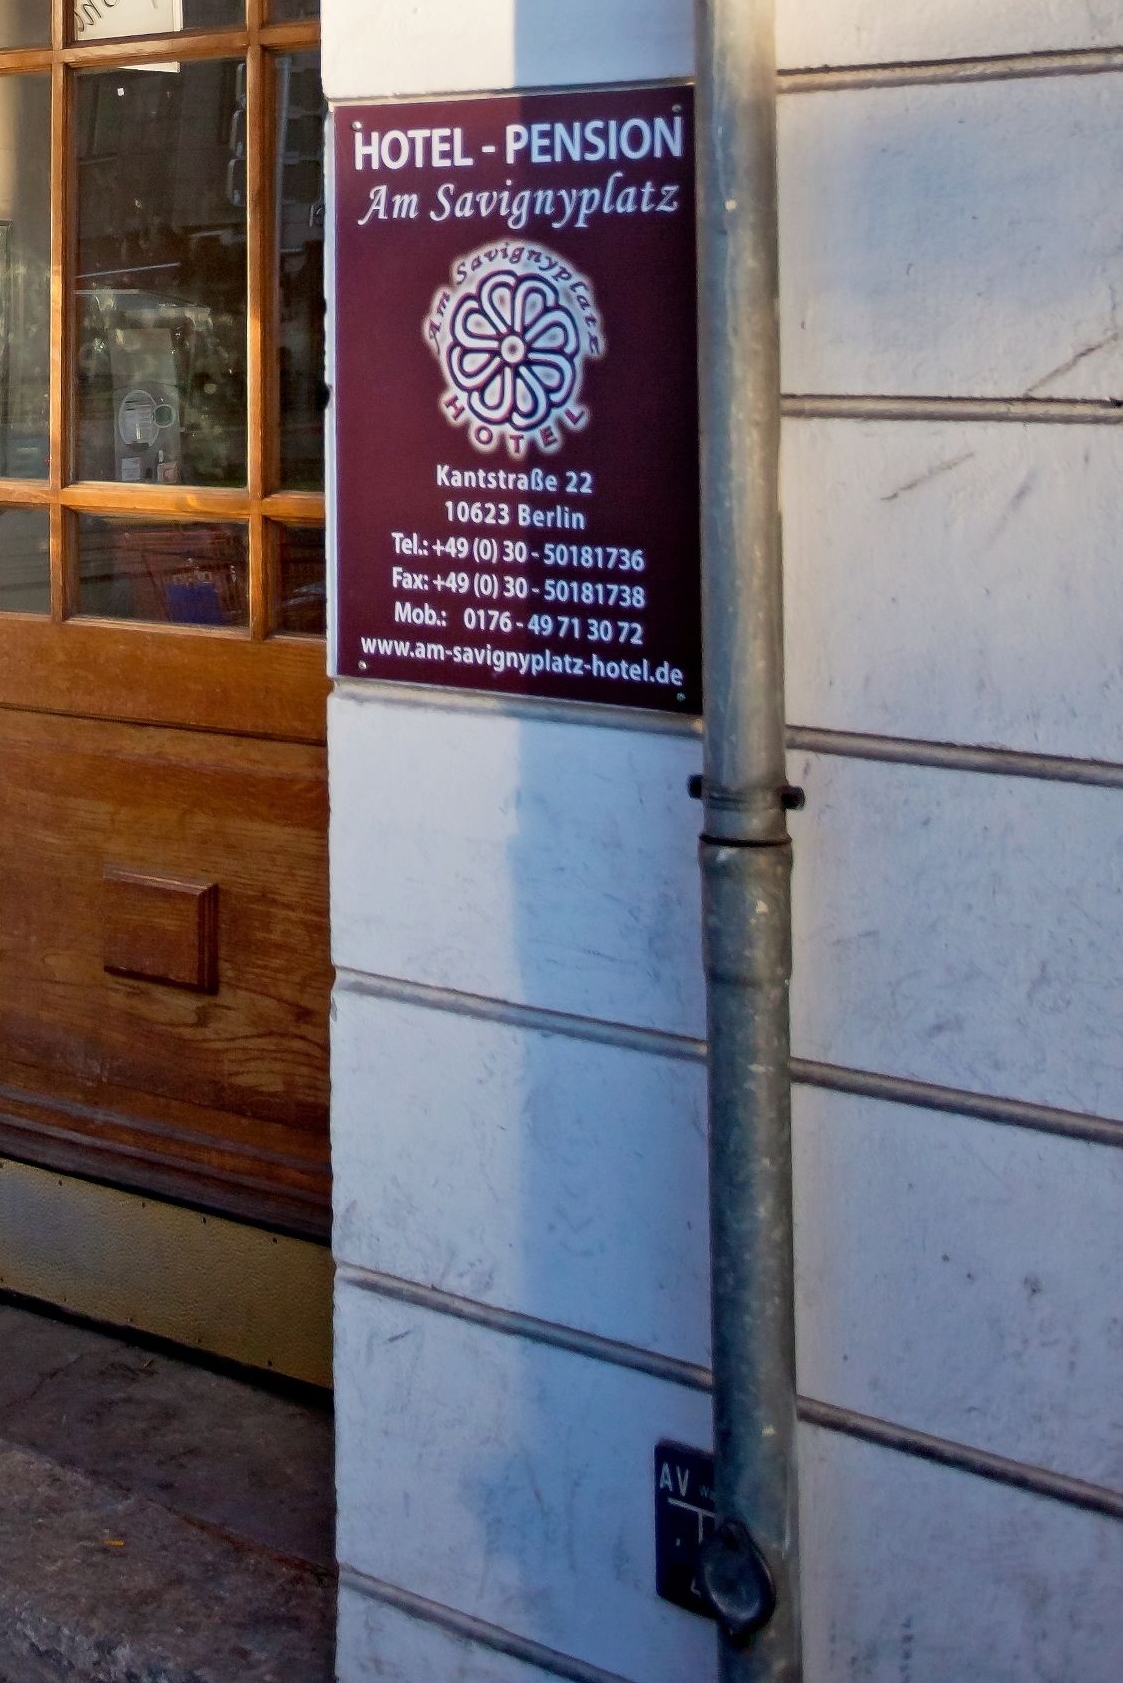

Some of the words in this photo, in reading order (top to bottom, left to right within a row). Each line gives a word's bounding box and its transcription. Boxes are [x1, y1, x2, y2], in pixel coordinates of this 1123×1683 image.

[354, 127, 474, 171] HOTEL
[481, 145, 496, 154] -
[505, 115, 683, 164] PENSION
[357, 183, 420, 227] Am
[429, 171, 679, 230] Savignyplatz
[429, 291, 452, 354] Am
[456, 242, 600, 354] Savignyplatz
[444, 393, 584, 454] HOTEL
[436, 464, 558, 494] Kantstraße
[565, 470, 594, 495] 22
[444, 501, 510, 525] 10623
[518, 503, 586, 530] Berlin
[391, 532, 429, 556] Tel.:
[432, 537, 469, 559] +49
[473, 538, 498, 564] (0)
[503, 541, 527, 563] 30
[543, 543, 646, 572] 50181736
[391, 566, 429, 591] Fax:
[433, 572, 470, 595] +49
[473, 573, 499, 600] (0)
[503, 576, 528, 599] 30
[544, 578, 646, 609] 50181738
[394, 601, 447, 627] Mob.:
[463, 607, 512, 633] 0176
[527, 614, 553, 637] 49
[557, 615, 581, 639] 71
[587, 618, 613, 643] 30
[618, 621, 644, 645] 72
[360, 636, 684, 687] www.am-savignyplatz-hotel.de
